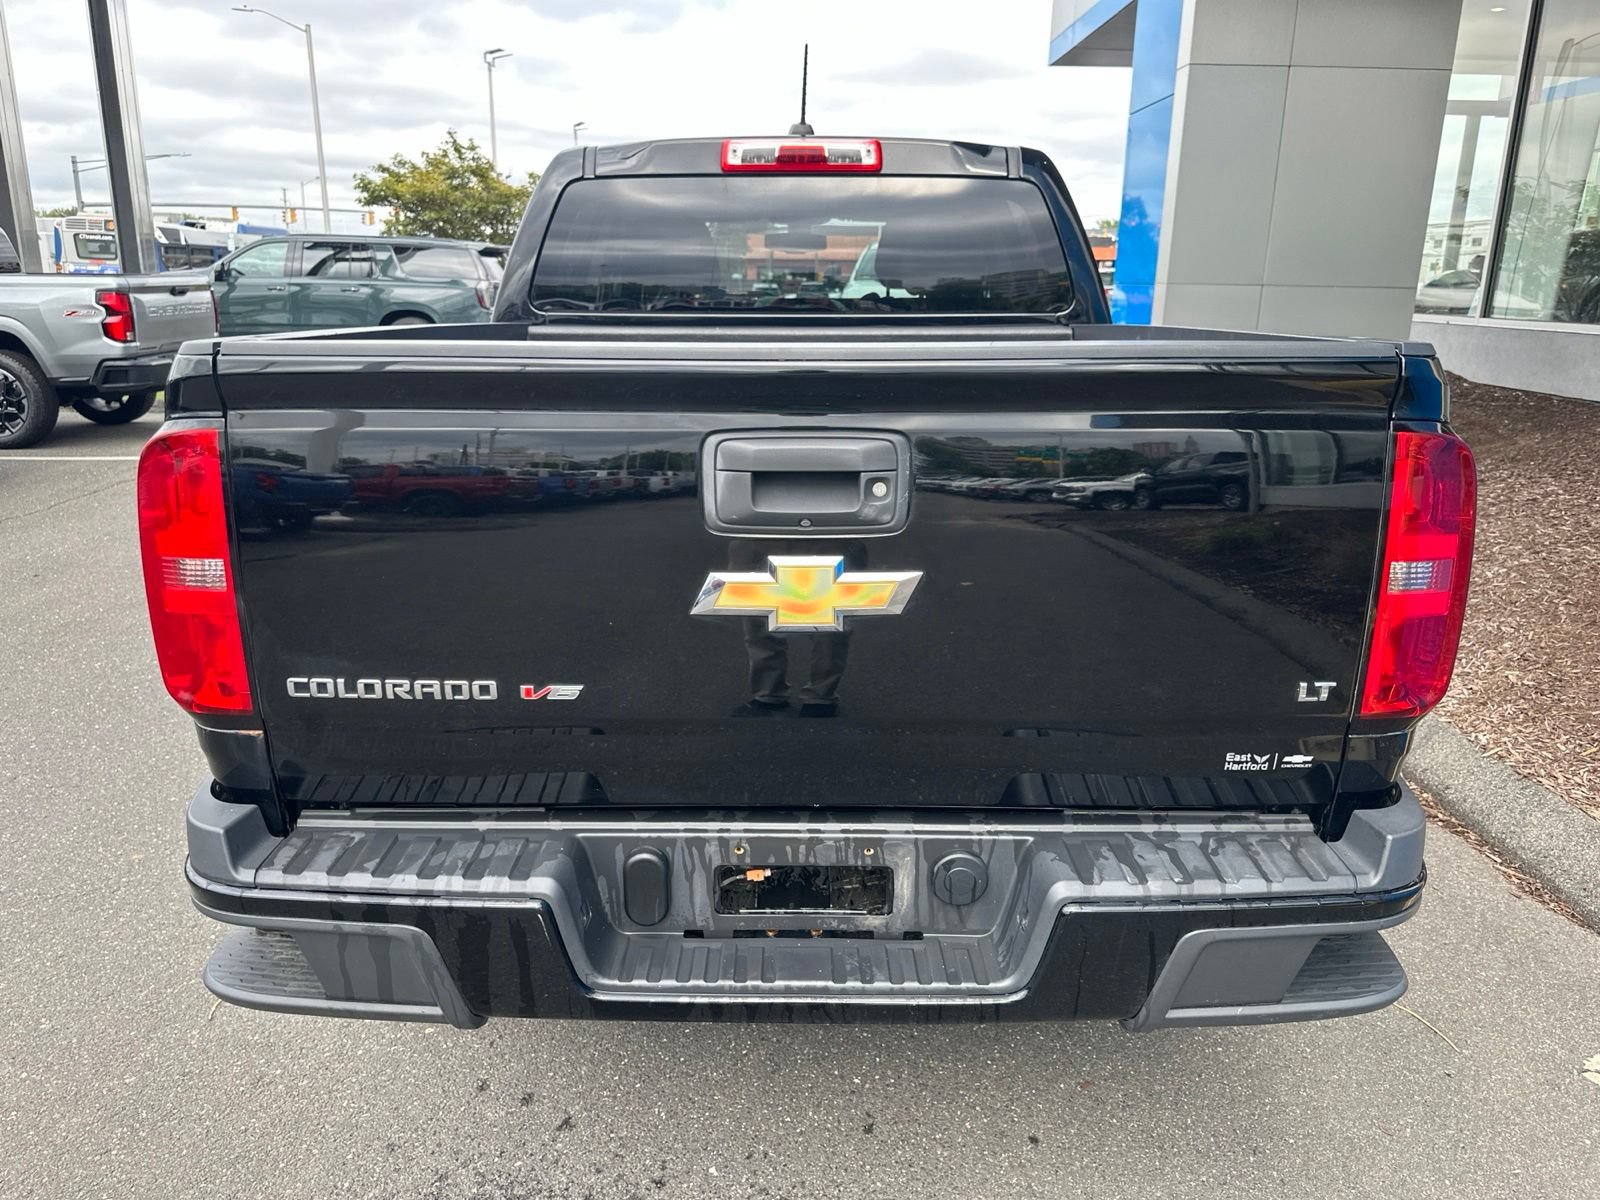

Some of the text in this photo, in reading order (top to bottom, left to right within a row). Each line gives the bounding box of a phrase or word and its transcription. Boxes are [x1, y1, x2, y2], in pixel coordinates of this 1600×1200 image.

[286, 677, 584, 701] COLORADO V6
[1297, 682, 1337, 702] LT
[1225, 752, 1251, 761] East
[1224, 761, 1269, 771] Hartford
